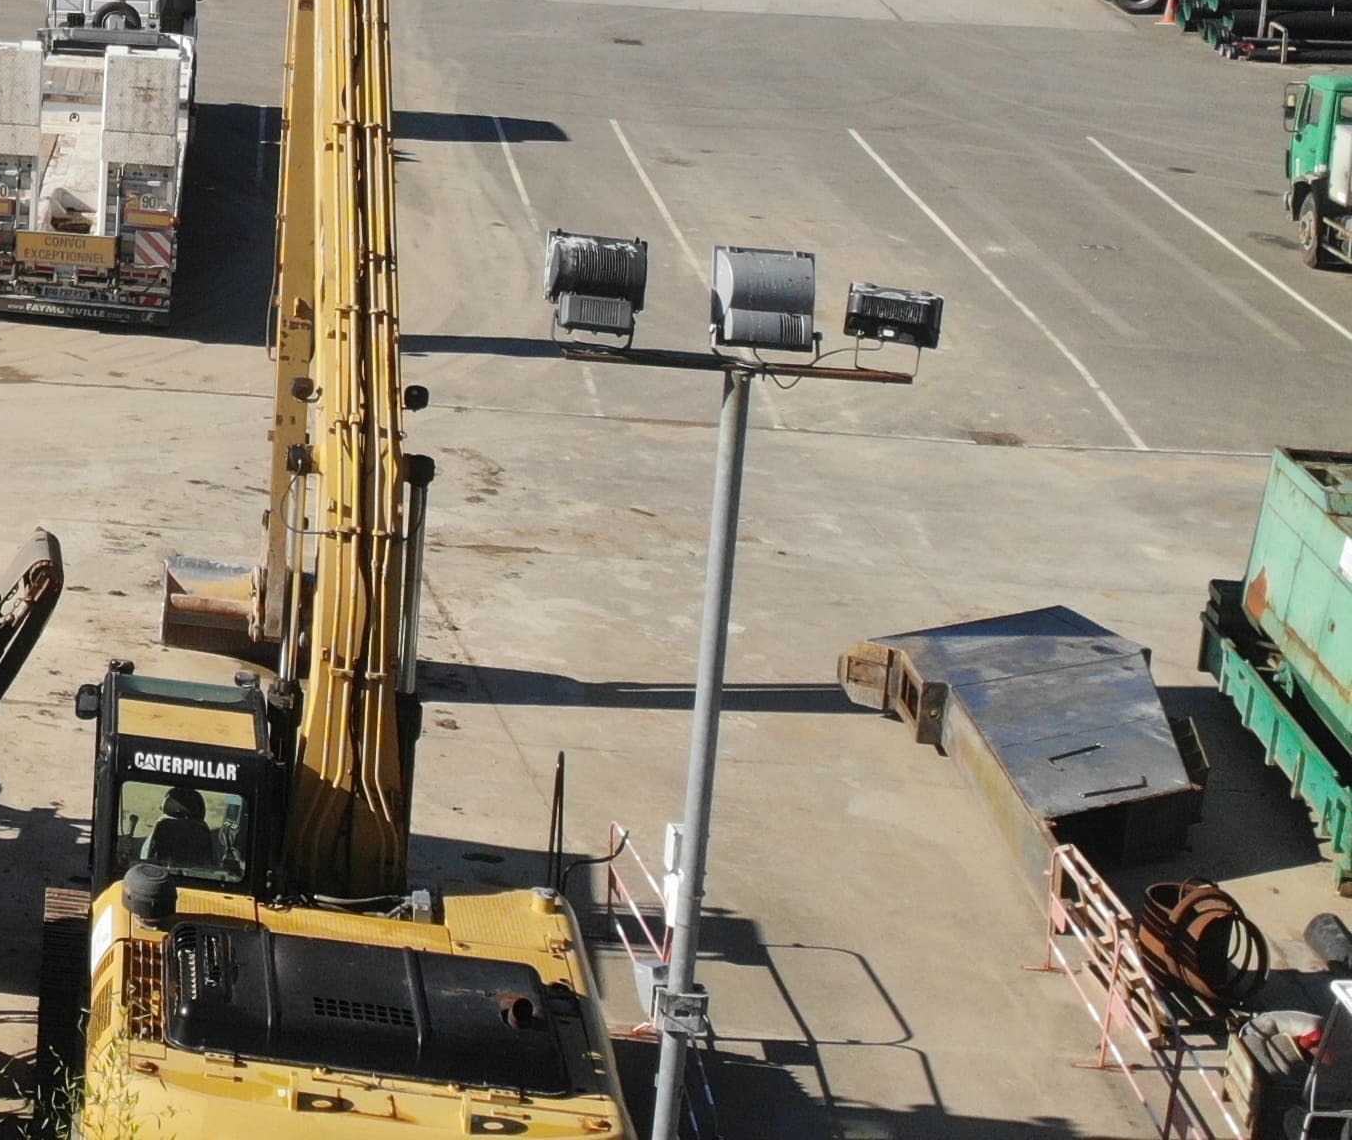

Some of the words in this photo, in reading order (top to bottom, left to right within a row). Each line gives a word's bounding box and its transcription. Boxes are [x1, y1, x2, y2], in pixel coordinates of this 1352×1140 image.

[141, 195, 157, 208] 90
[44, 236, 87, 249] CONVOI
[23, 249, 105, 262] EXCEPTIONNEL
[134, 751, 237, 781] CATERPILLAR
